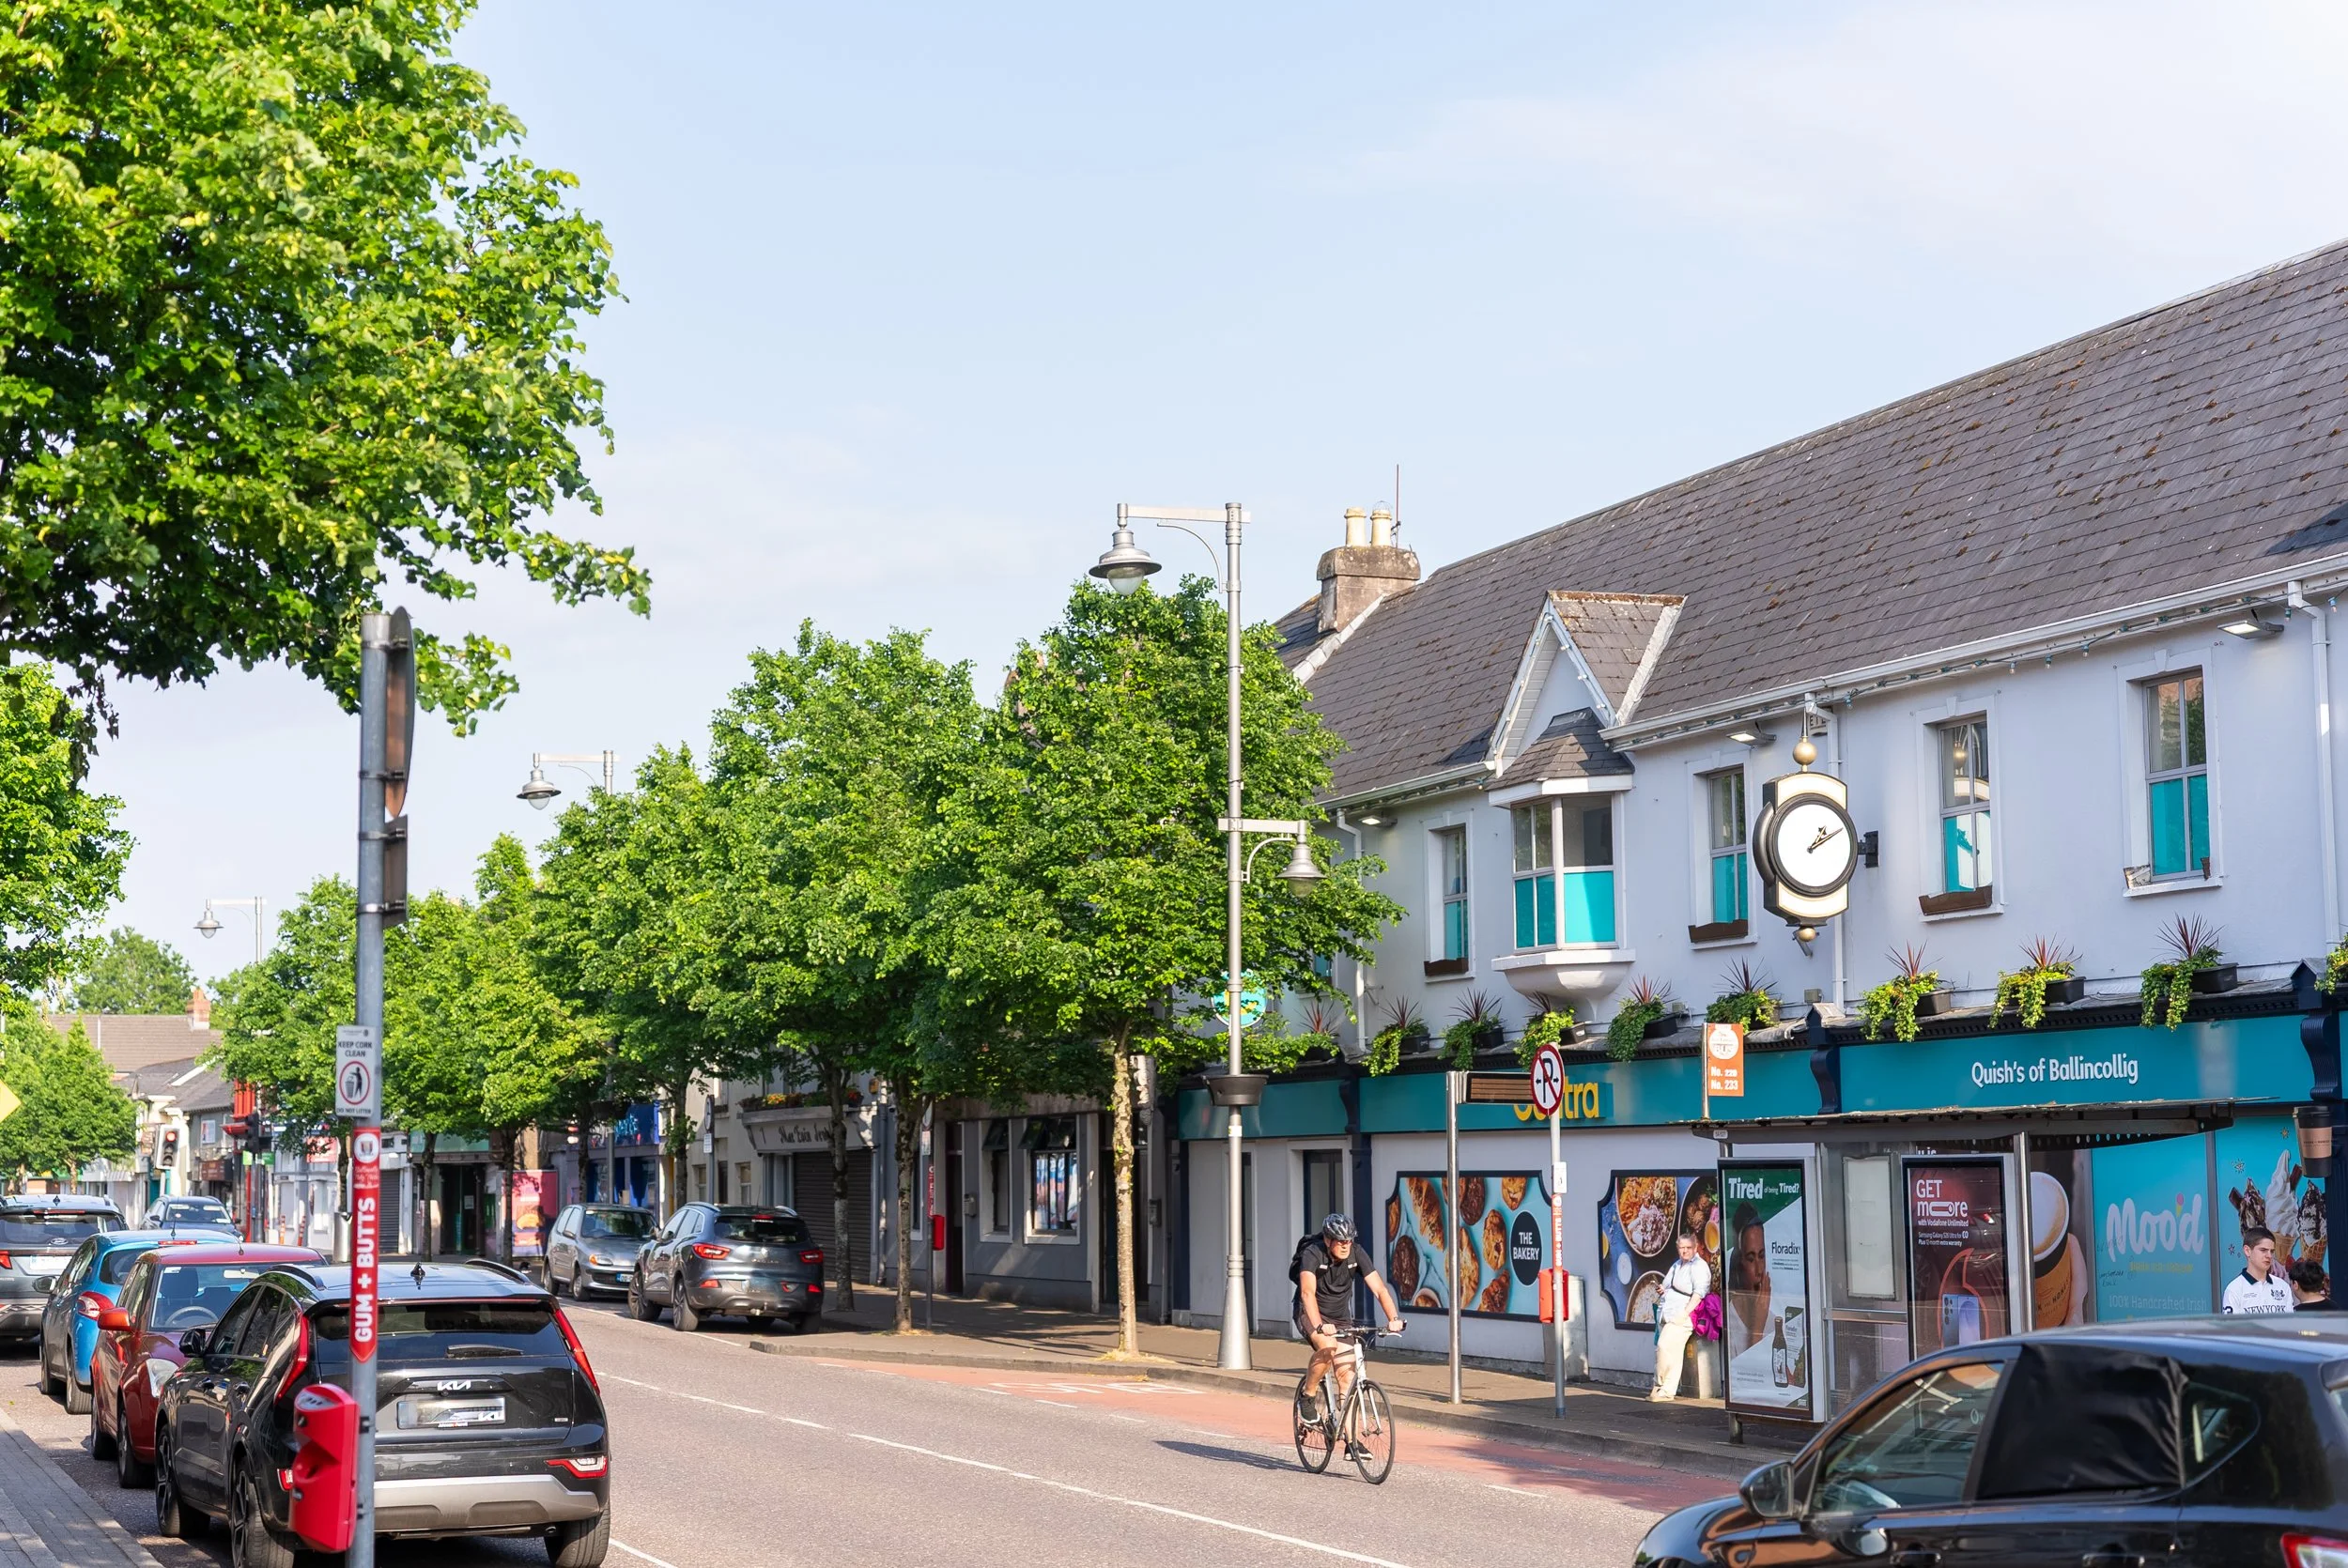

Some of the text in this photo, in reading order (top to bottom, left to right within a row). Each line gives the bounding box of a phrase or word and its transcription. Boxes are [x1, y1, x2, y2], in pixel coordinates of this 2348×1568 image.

[1711, 1067, 1722, 1077] No.
[1972, 1053, 2138, 1088] Quish's of Ballincollig
[1711, 1080, 1722, 1090] No.
[1728, 1176, 1764, 1199] Tired
[1769, 1186, 1779, 1194] being
[1779, 1182, 1800, 1193] Tired?
[1916, 1179, 1942, 1198] GET
[356, 1197, 376, 1268] BUTTS
[1519, 1232, 1533, 1244] THE
[1513, 1248, 1539, 1260] BAKERY
[1771, 1241, 1800, 1254] Floradix
[2109, 1295, 2207, 1312] 100% Handcrafted Irish
[355, 1294, 374, 1343] GUM
[437, 1380, 471, 1391] KIA
